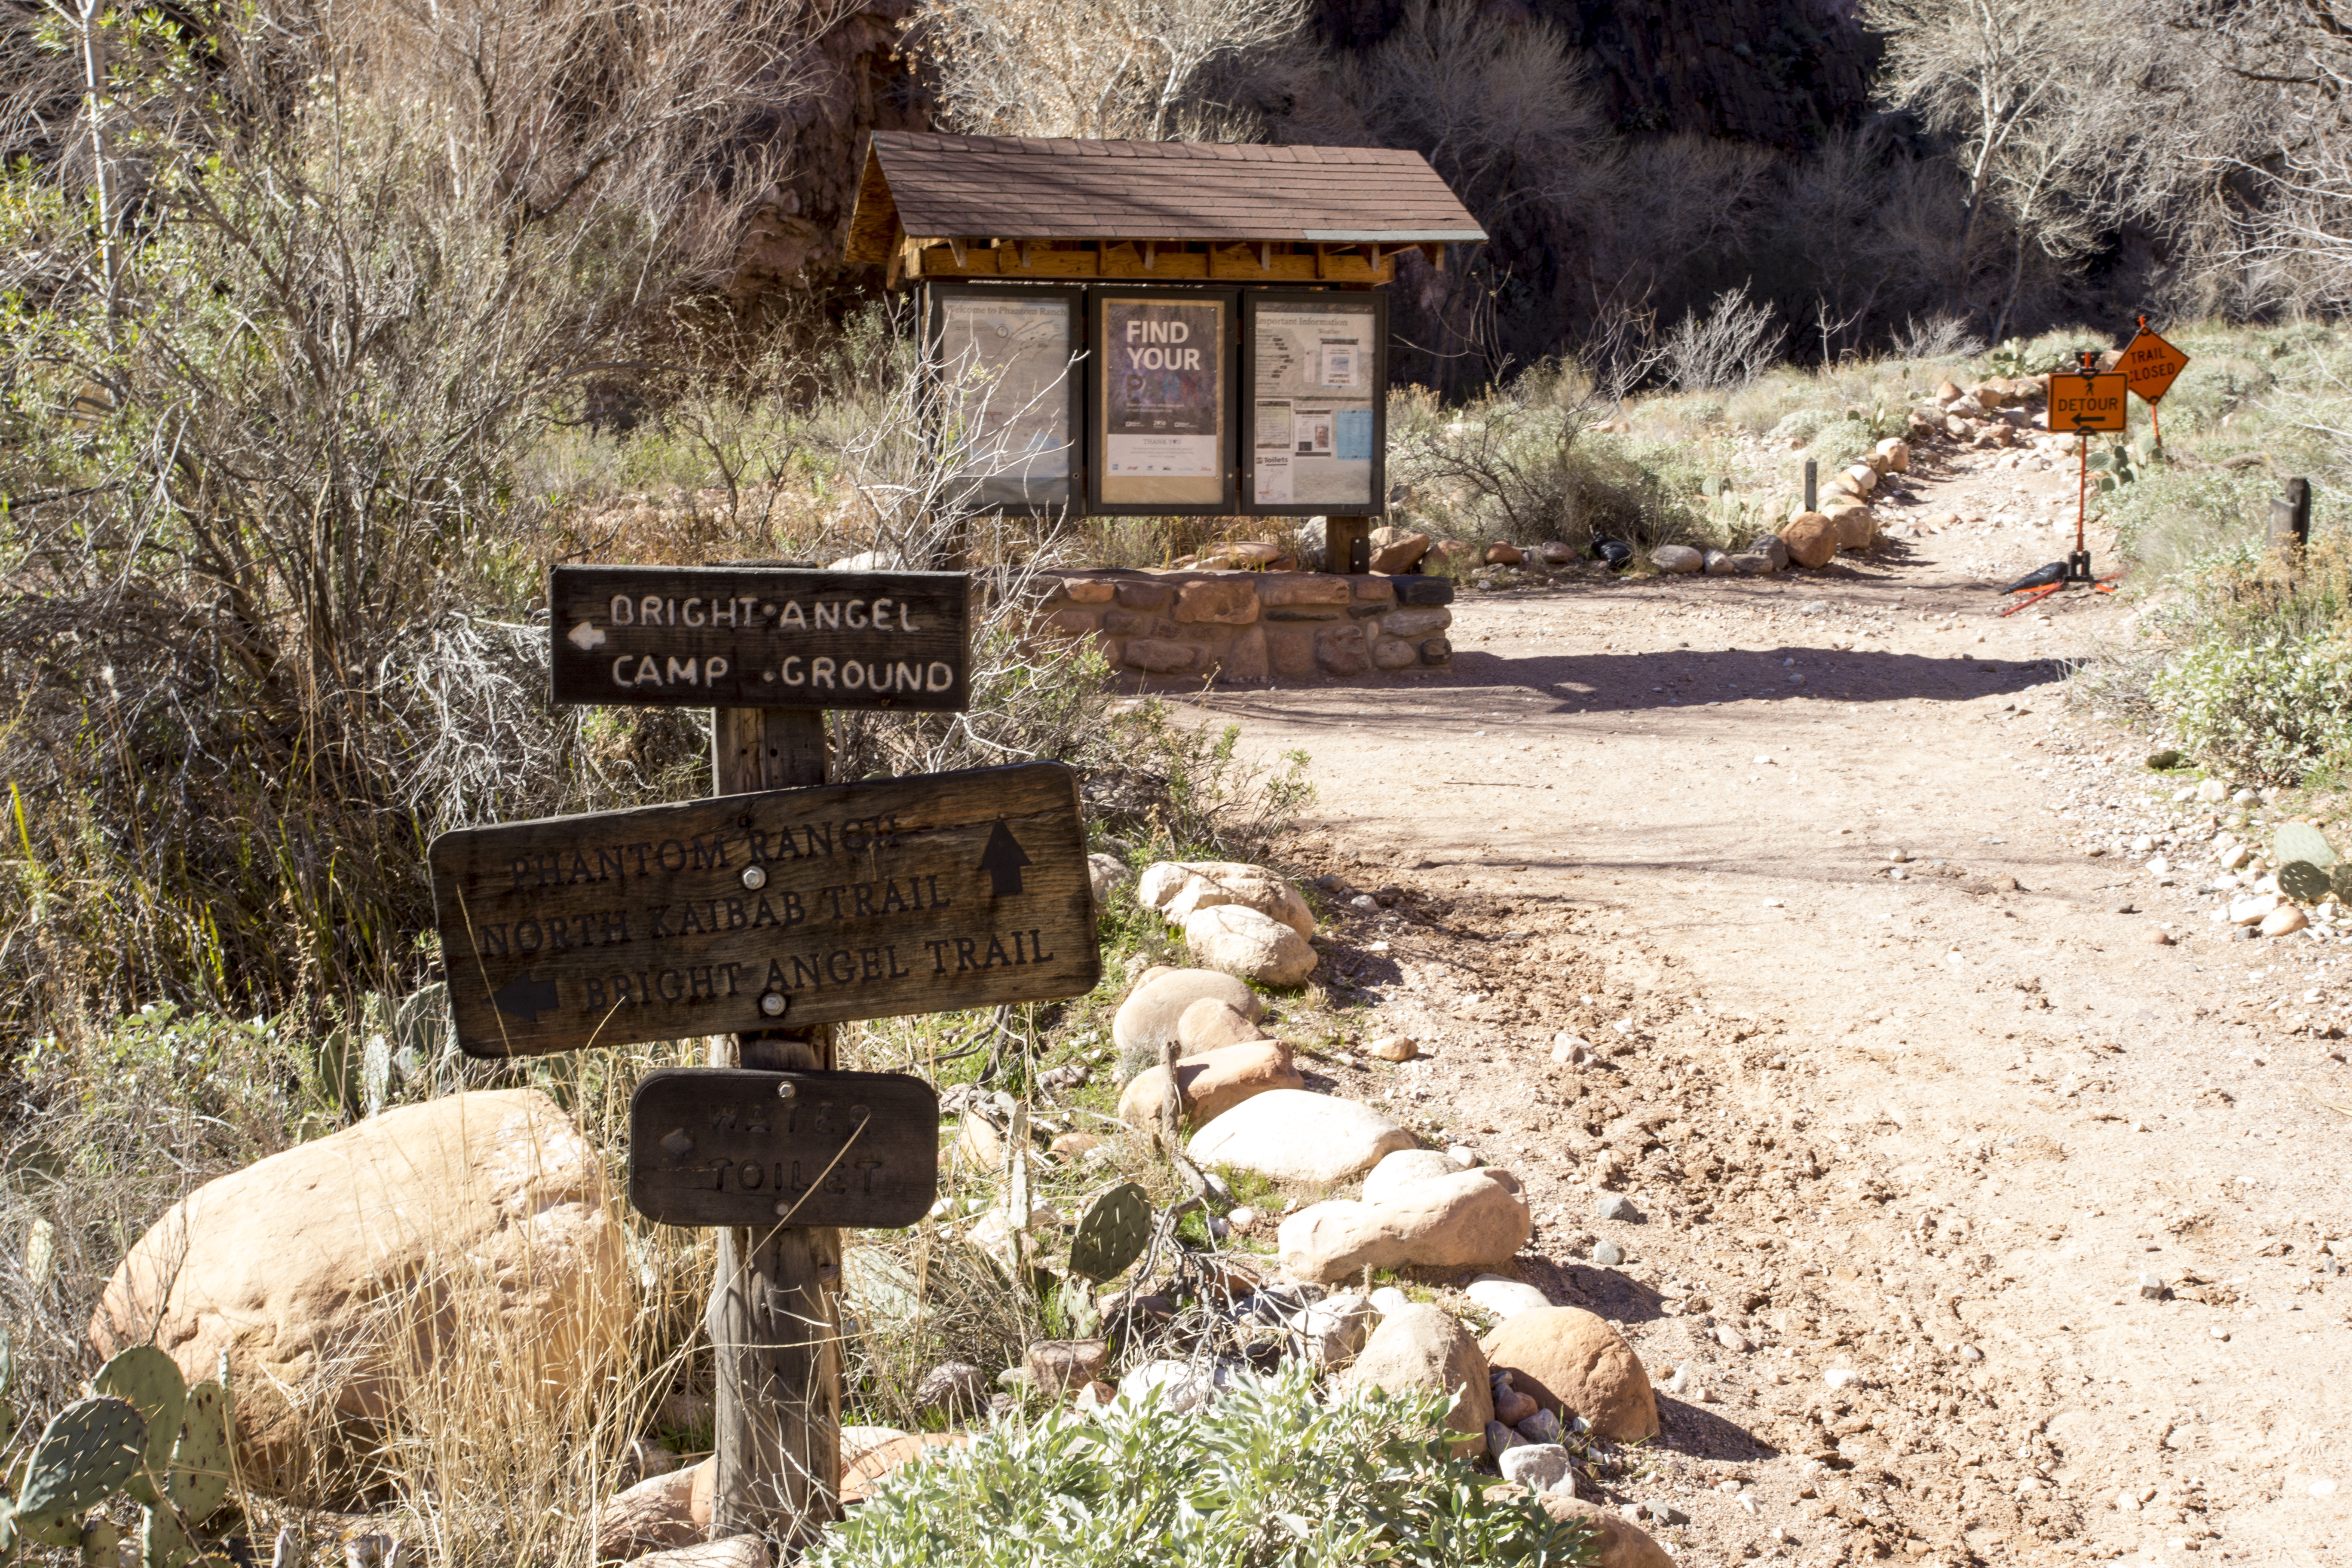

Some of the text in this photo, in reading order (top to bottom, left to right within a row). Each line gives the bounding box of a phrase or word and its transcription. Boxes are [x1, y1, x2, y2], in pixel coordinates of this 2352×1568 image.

[947, 304, 986, 313] Welcome
[998, 306, 1038, 315] Phantom
[1040, 307, 1067, 316] Ranch
[1256, 317, 1348, 327] Important Information
[1127, 321, 1189, 343] FIND
[1126, 347, 1200, 370] YOUR
[2130, 347, 2166, 364] TRAIL
[1127, 374, 1200, 400] PARK
[2058, 398, 2118, 411] DETOUR
[610, 594, 921, 632] BRIGHT ANGEL
[612, 655, 953, 693] CAMP GROUND
[511, 814, 900, 891] PHANTOM RANCH
[479, 874, 951, 957] NORTH KAIBAB TRAIL
[582, 929, 1054, 1011] BRIGHT ANGEL TRAIL
[710, 1101, 871, 1135] WATER
[707, 1157, 882, 1195] TOILET
